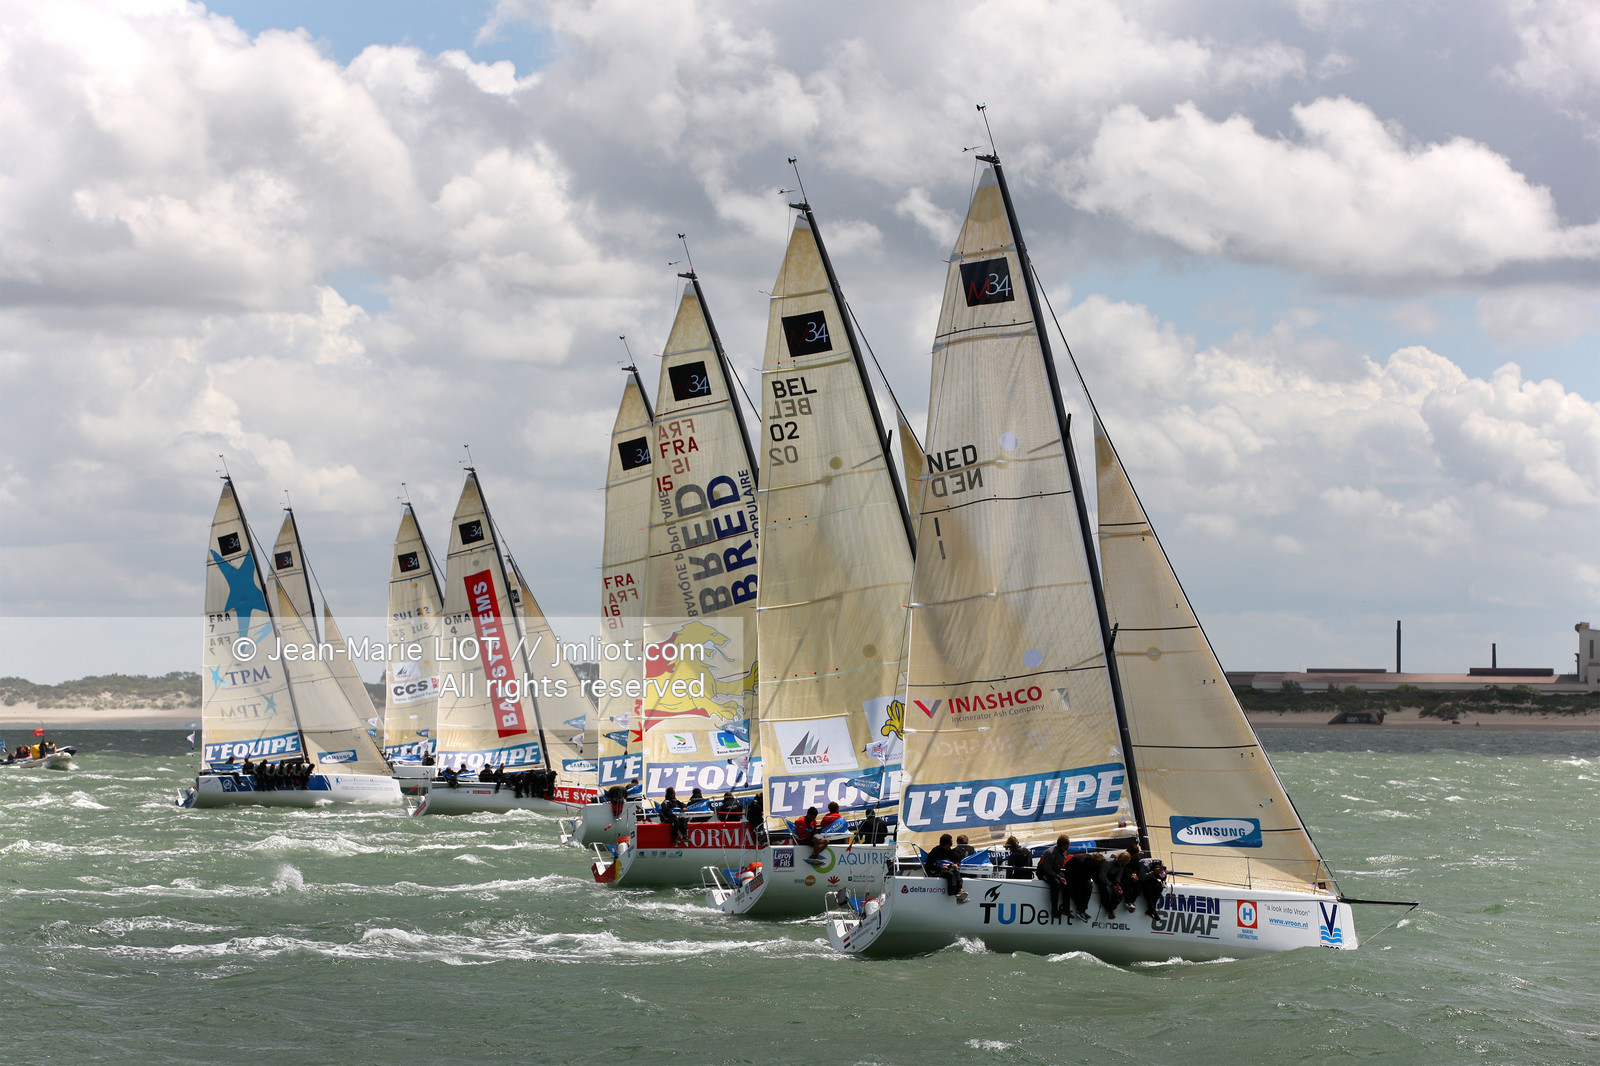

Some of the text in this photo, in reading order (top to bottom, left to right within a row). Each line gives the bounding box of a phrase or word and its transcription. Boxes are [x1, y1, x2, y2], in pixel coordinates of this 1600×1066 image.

[967, 273, 1012, 303] M34
[771, 376, 818, 399] BEL
[769, 420, 800, 442] 02
[659, 436, 699, 459] FRA
[926, 445, 979, 474] NED
[656, 475, 674, 493] 15
[706, 475, 759, 605] BRED
[603, 573, 635, 590] FRA
[209, 612, 231, 624] FRA
[393, 610, 413, 622] SUI
[604, 604, 621, 618] 16
[444, 612, 471, 626] OMA
[209, 624, 215, 634] 7
[450, 626, 458, 635] 4
[225, 664, 273, 686] TPM
[393, 680, 428, 697] CCS
[948, 686, 1043, 714] INASHCO
[952, 703, 1045, 723] Incinerator Ash Company
[787, 754, 830, 768] TEAM34
[1186, 826, 1246, 838] SAMSUNG
[774, 850, 793, 861] Leroy
[780, 859, 791, 869] Fils
[1270, 904, 1282, 913] look
[1091, 921, 1131, 931] FONDEL
[1151, 910, 1220, 936] GINAF
[1269, 918, 1309, 928] www.vroon.nl
